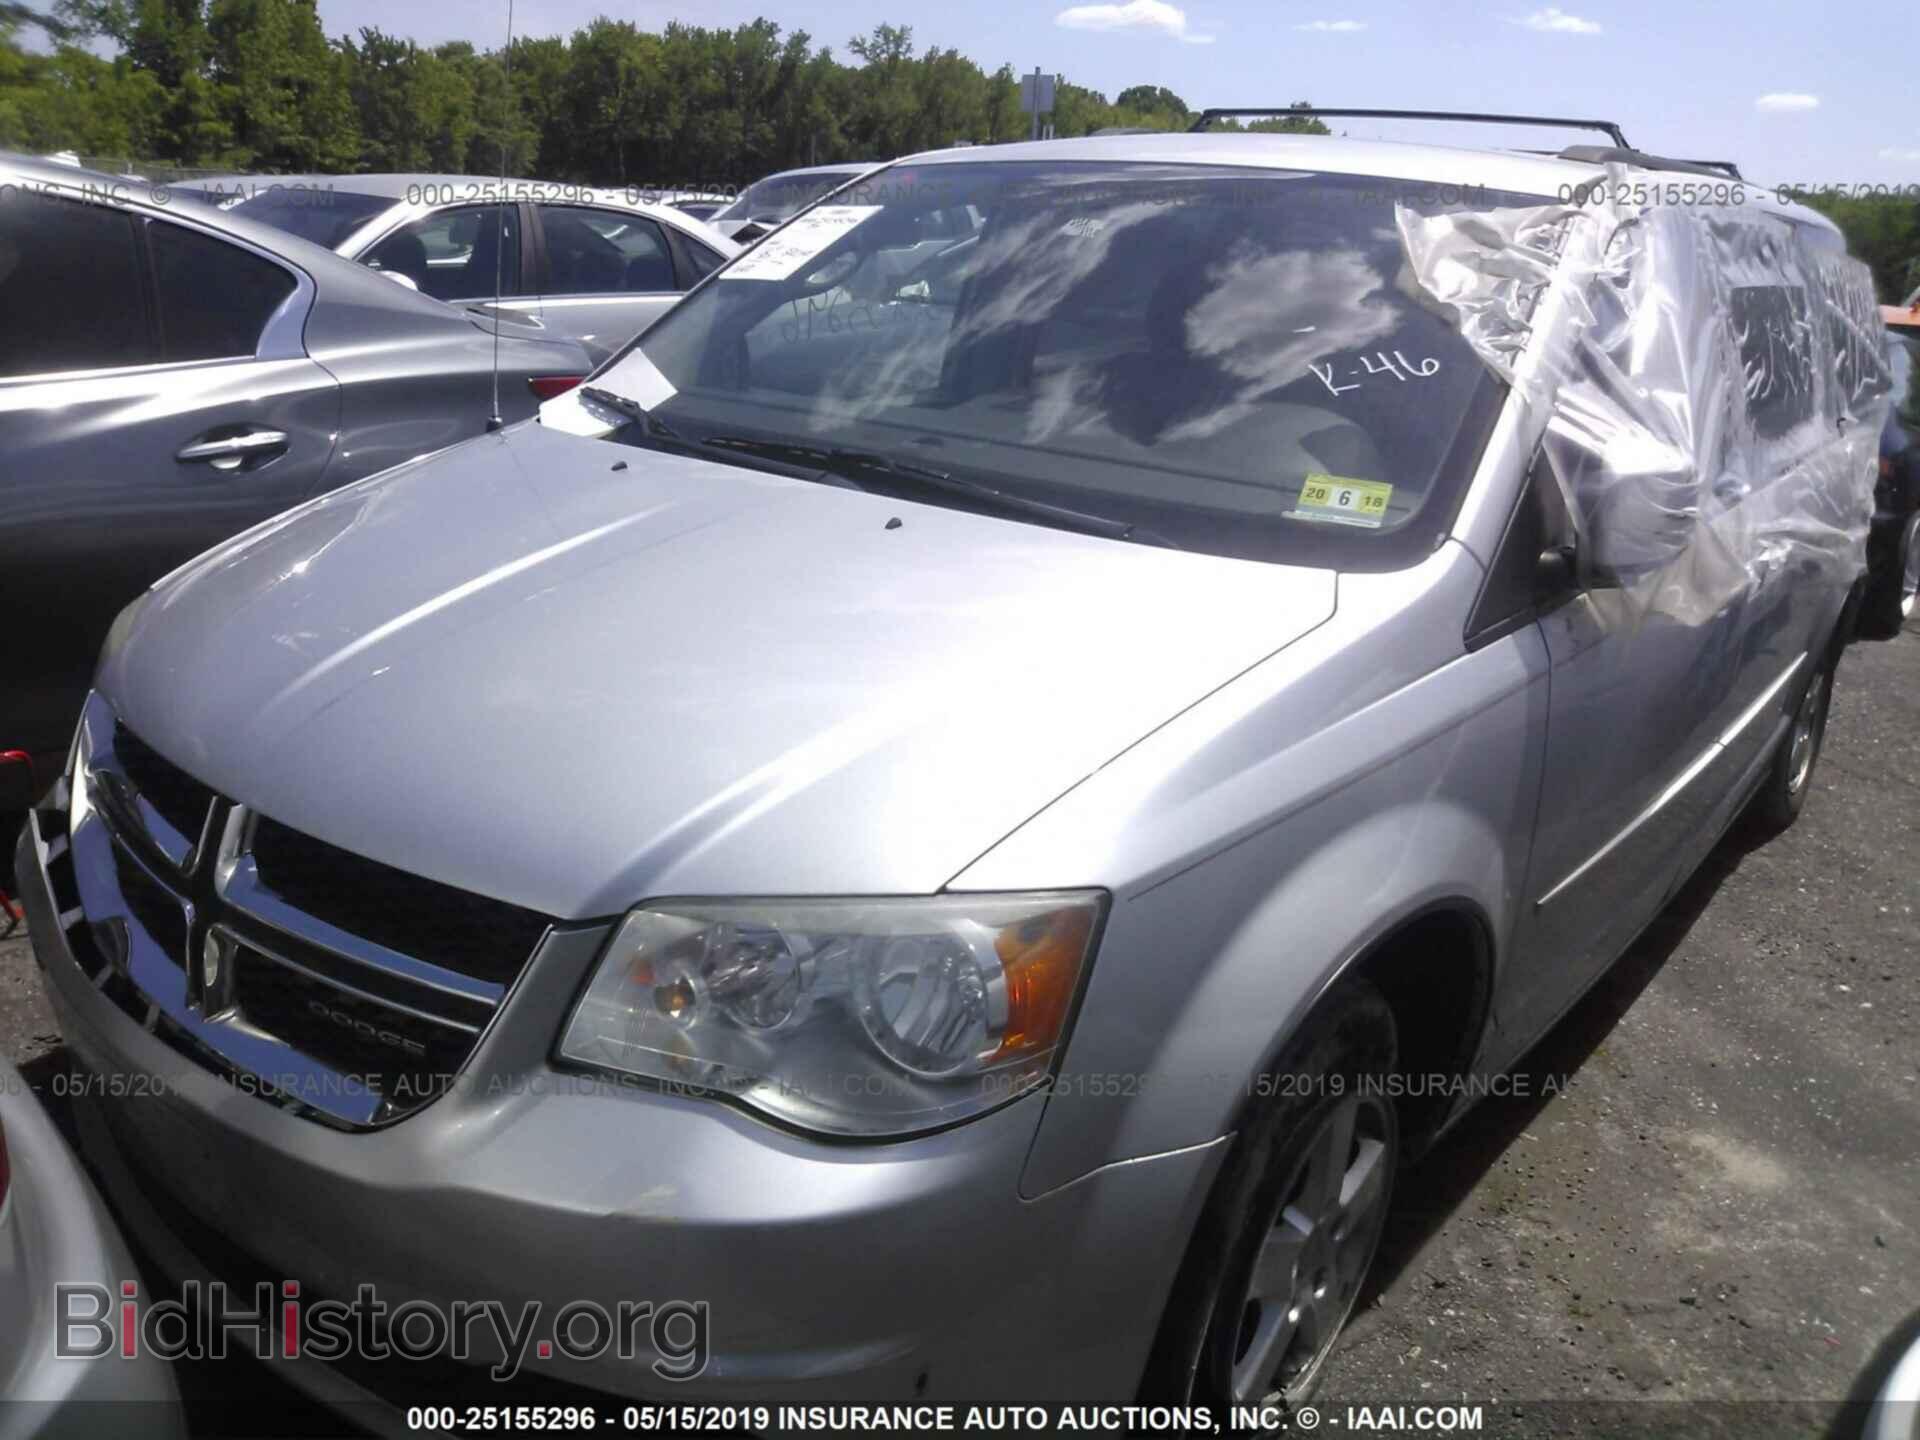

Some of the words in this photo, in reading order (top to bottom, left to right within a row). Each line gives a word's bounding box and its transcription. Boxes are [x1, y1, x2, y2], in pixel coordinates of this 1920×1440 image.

[1308, 350, 1440, 396] K-46
[1306, 487, 1326, 500] 20
[1338, 490, 1352, 506] 6
[1365, 495, 1384, 508] 18
[309, 1000, 426, 1057] DODGE
